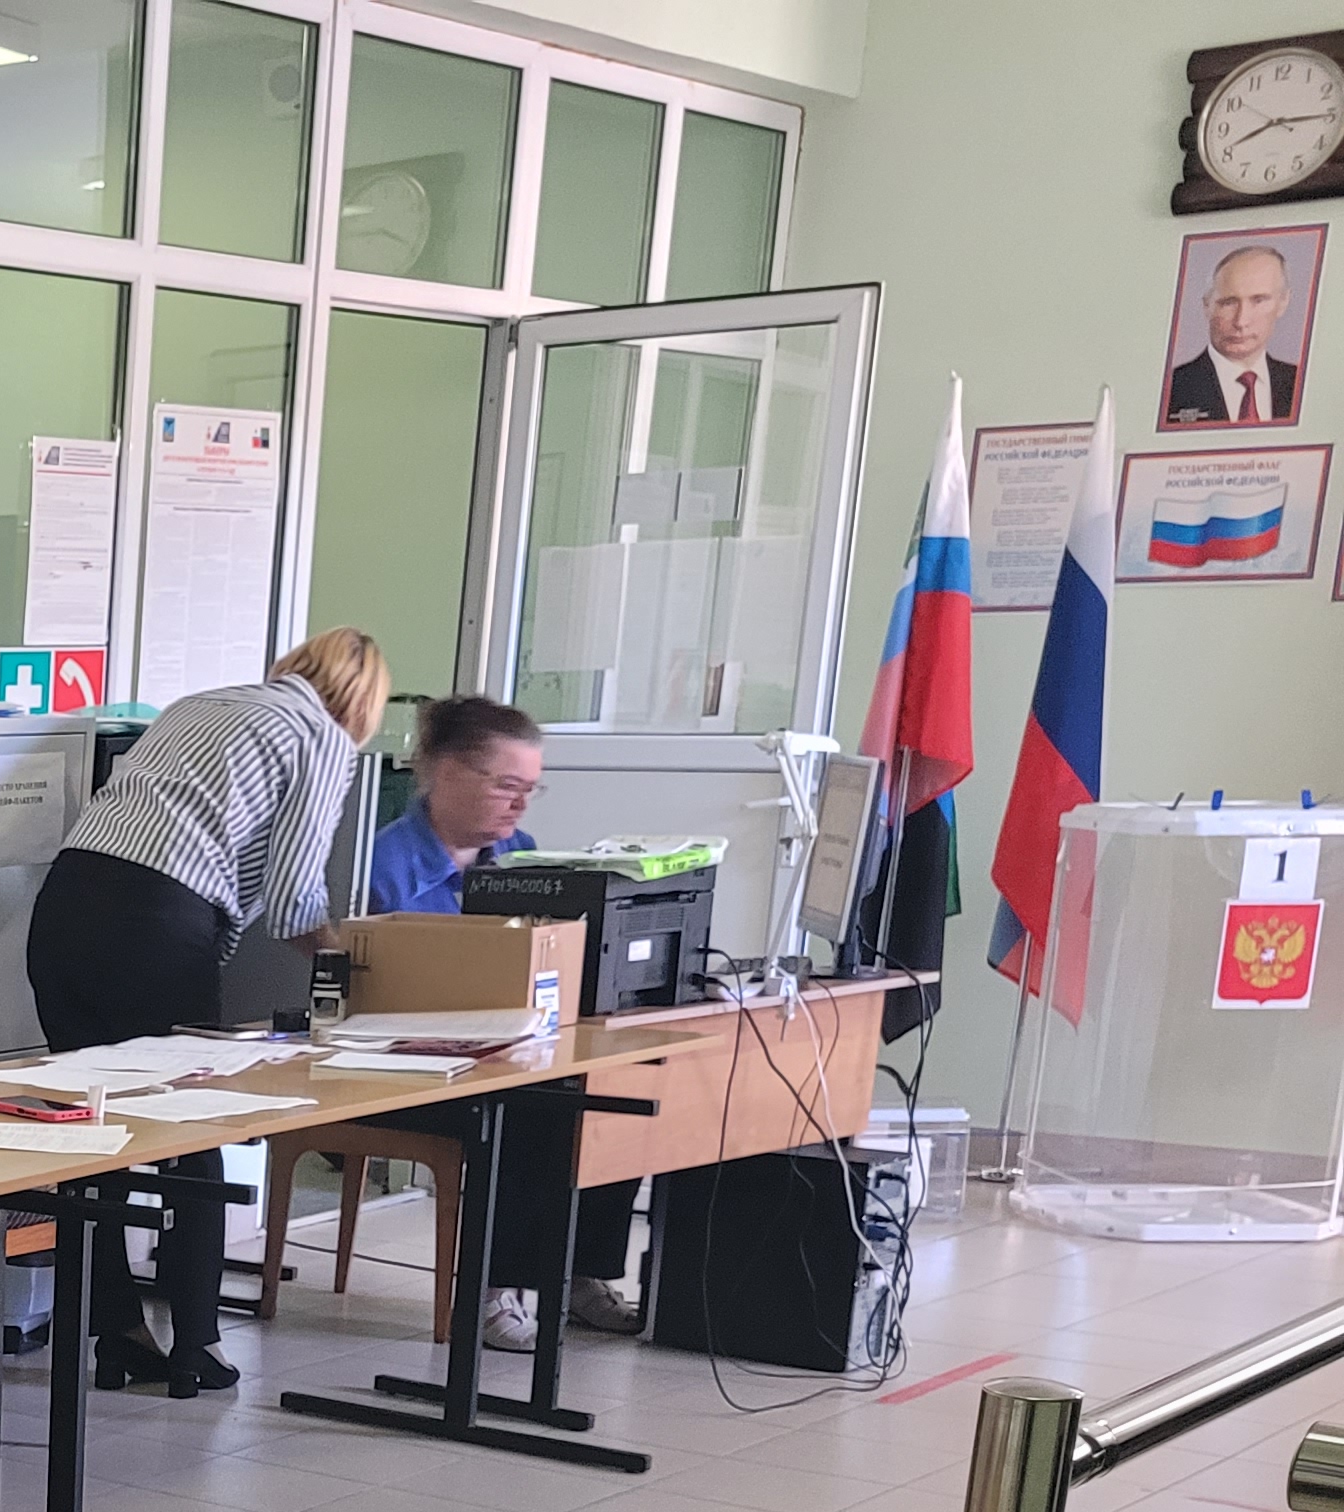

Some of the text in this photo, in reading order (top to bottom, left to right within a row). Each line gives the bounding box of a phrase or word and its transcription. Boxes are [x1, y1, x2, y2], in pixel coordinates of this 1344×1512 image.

[1275, 63, 1292, 81] 12
[1305, 67, 1312, 83] 1
[1248, 75, 1263, 92] 11
[1320, 83, 1333, 100] 2
[1225, 96, 1242, 113] 10
[1323, 108, 1336, 124] 3
[1217, 122, 1230, 139] 9
[1313, 134, 1326, 151] 4
[1221, 146, 1233, 163] 8
[1291, 155, 1304, 171] 5
[1240, 162, 1251, 178] 7
[1264, 165, 1276, 182] 6
[1273, 850, 1288, 882] 1
